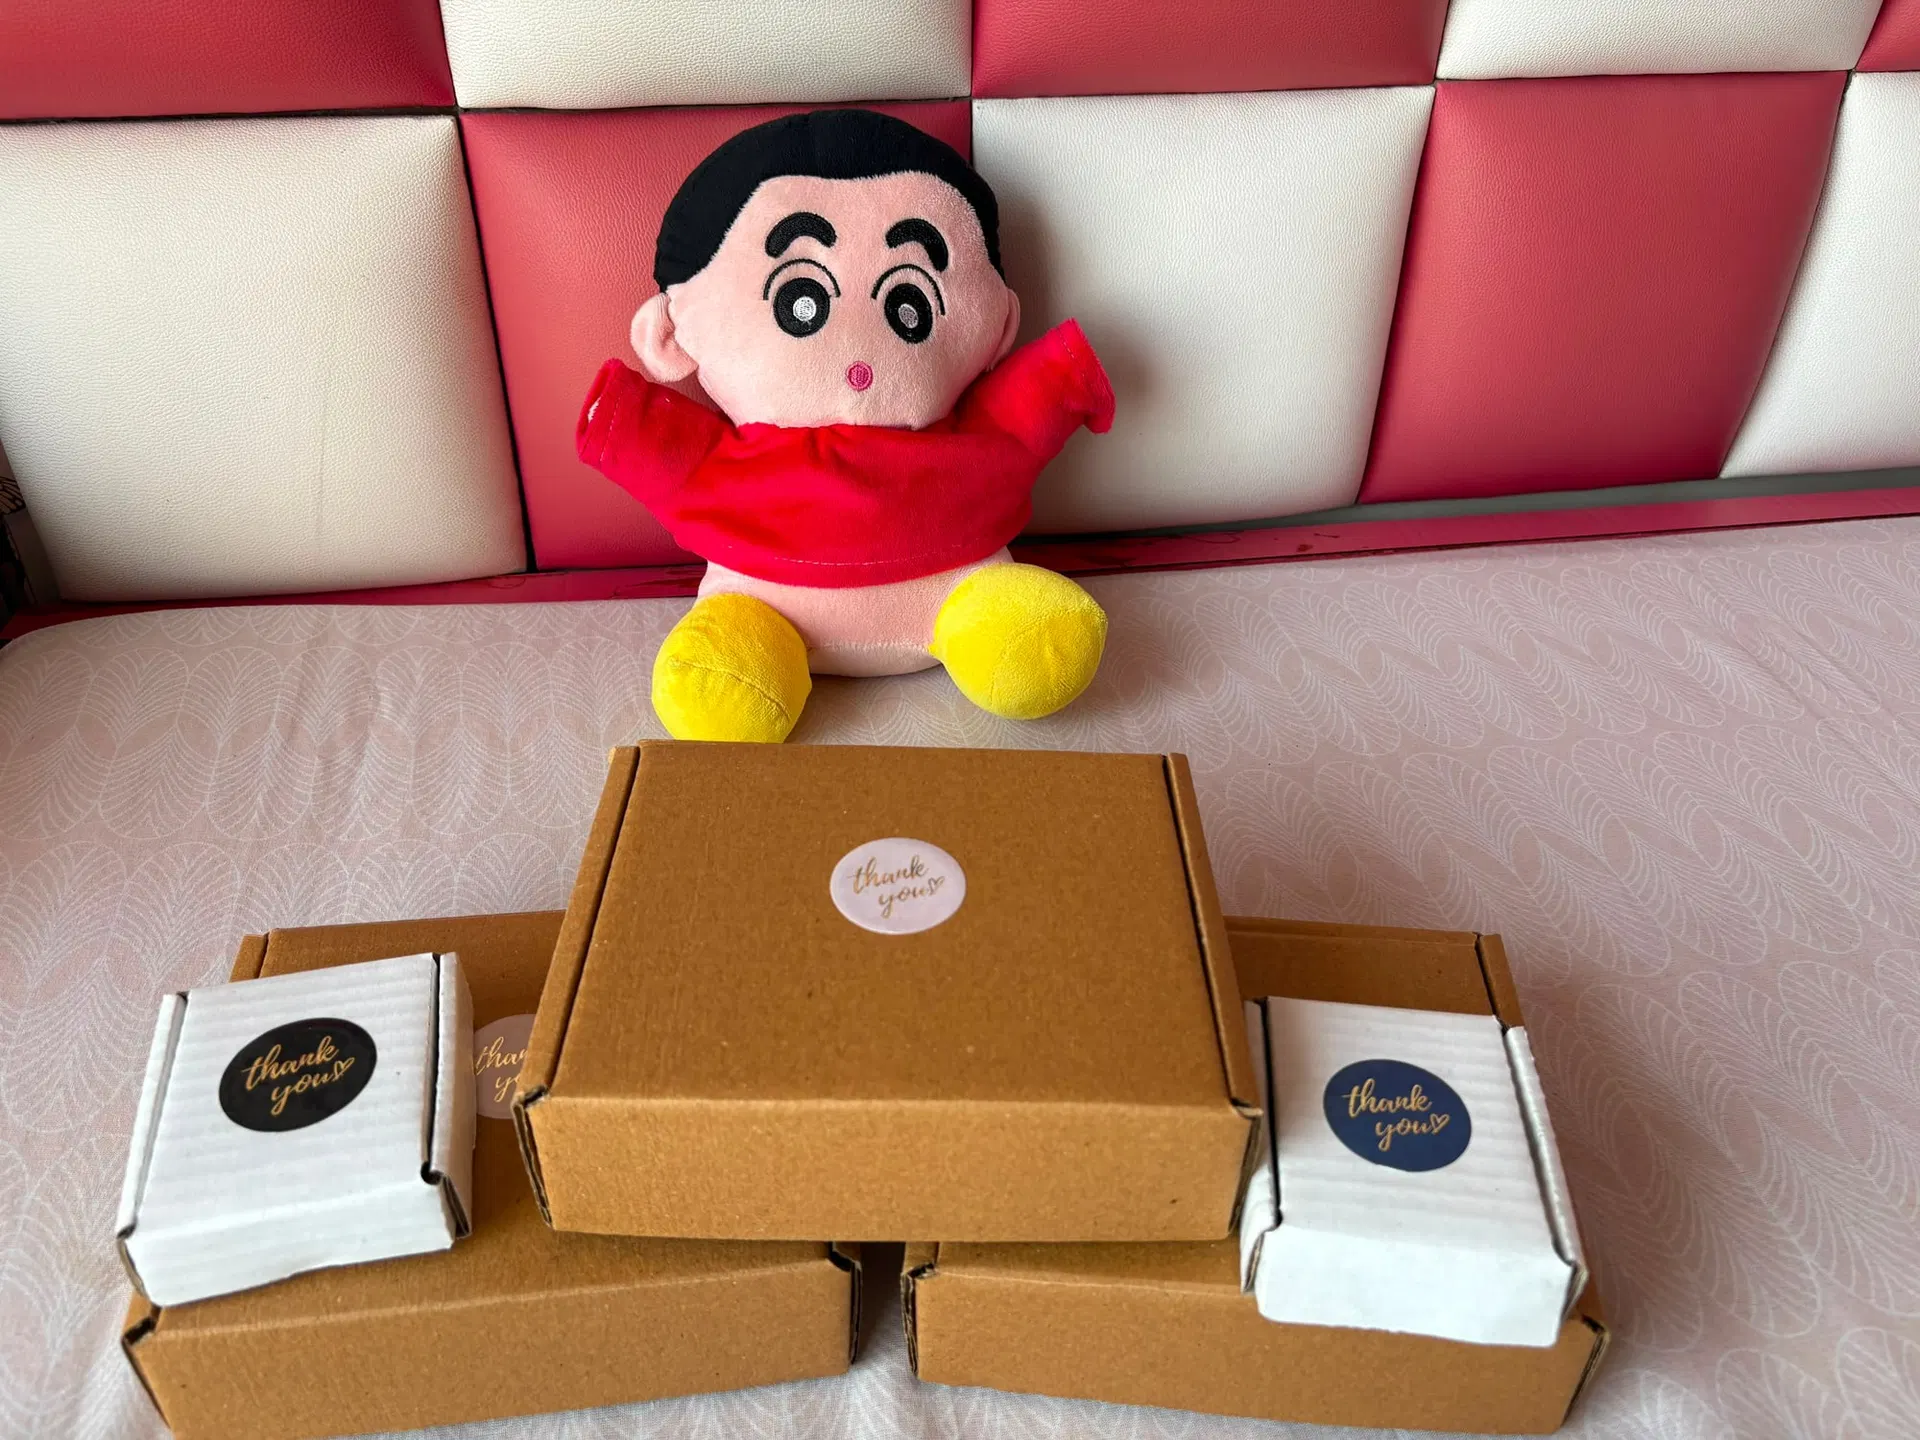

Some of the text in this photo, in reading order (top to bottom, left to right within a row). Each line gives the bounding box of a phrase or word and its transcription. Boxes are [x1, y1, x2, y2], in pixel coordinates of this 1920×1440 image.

[847, 853, 930, 894] thank
[878, 884, 931, 919] you
[242, 1035, 339, 1091] thank
[270, 1070, 334, 1116] you
[1341, 1078, 1432, 1118] thank
[1375, 1117, 1431, 1152] you
